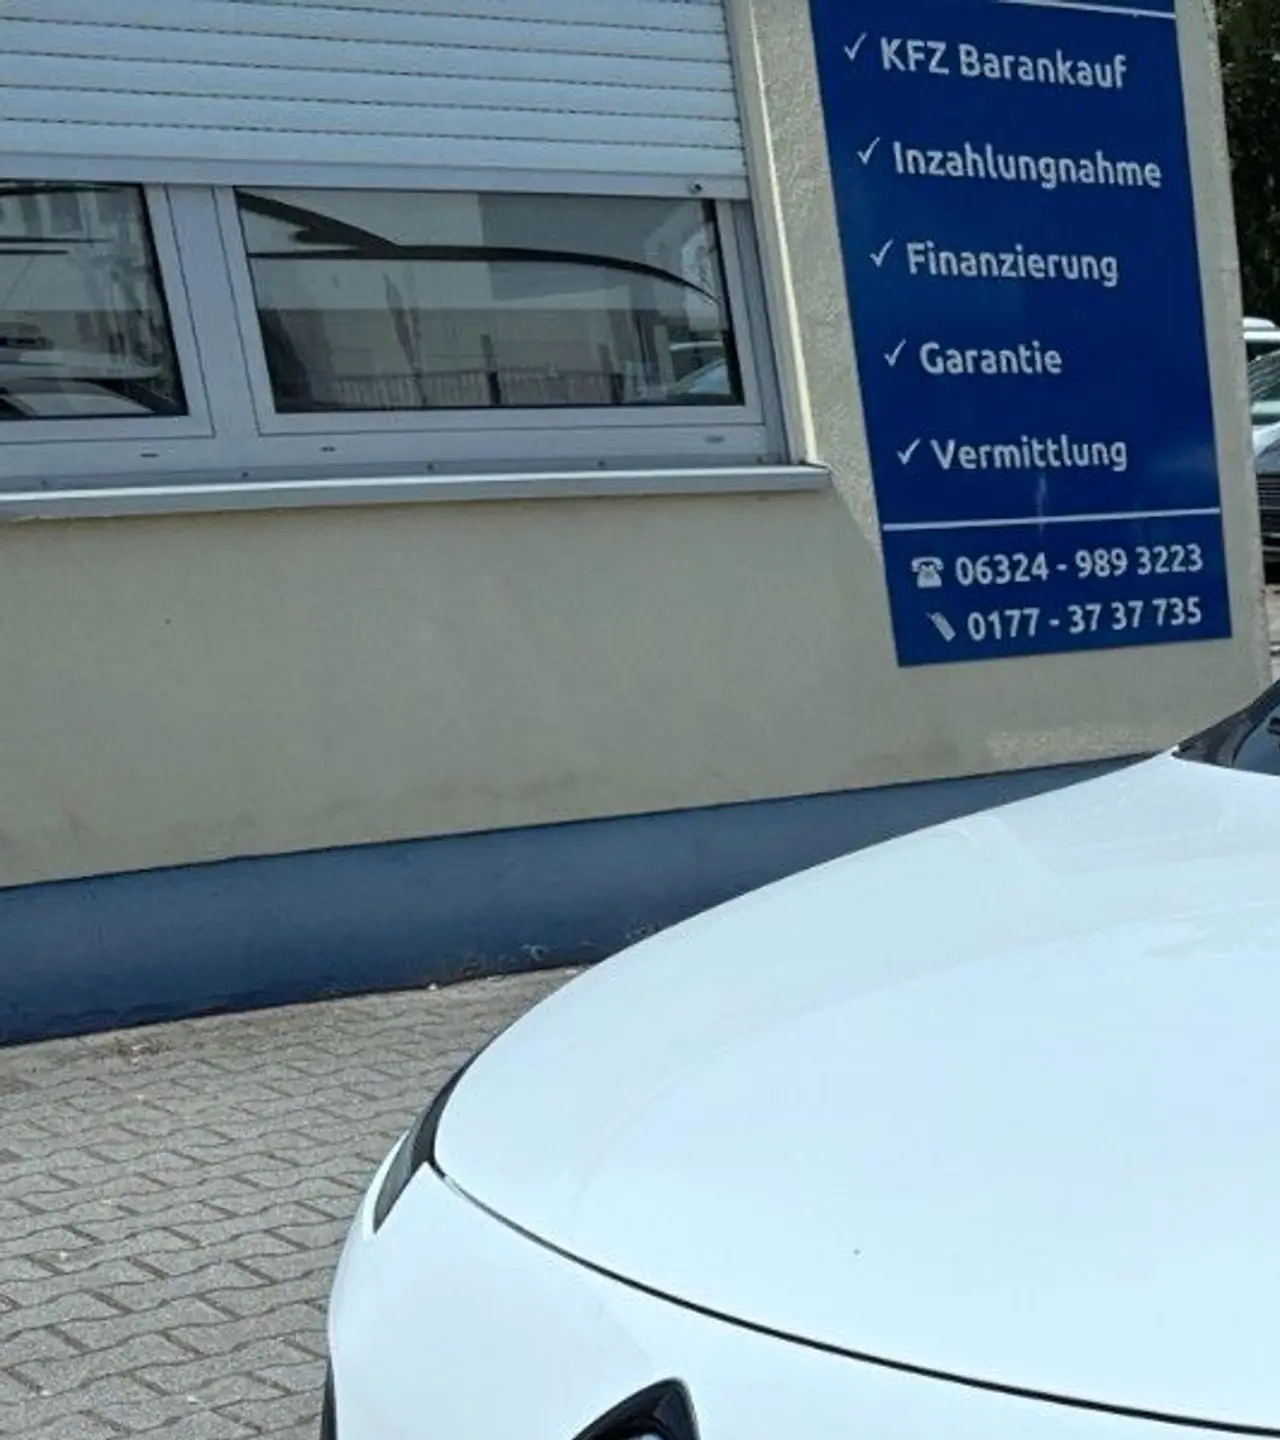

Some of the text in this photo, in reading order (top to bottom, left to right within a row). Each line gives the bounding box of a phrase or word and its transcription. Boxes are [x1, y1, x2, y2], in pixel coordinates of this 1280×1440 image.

[880, 37, 1127, 88] KFZ Barankauf
[893, 141, 1162, 189] Inzahlungnahme
[907, 240, 1118, 288] Finanzierung
[919, 340, 1062, 374] Garantie
[931, 434, 1127, 472] Vermittlung
[955, 552, 1050, 586] 06324
[1075, 548, 1128, 578] 989
[1135, 543, 1203, 575] 3223
[967, 607, 1040, 641] 0177
[1068, 603, 1102, 634] 37
[1111, 600, 1144, 630] 37
[1152, 596, 1202, 626] 735
